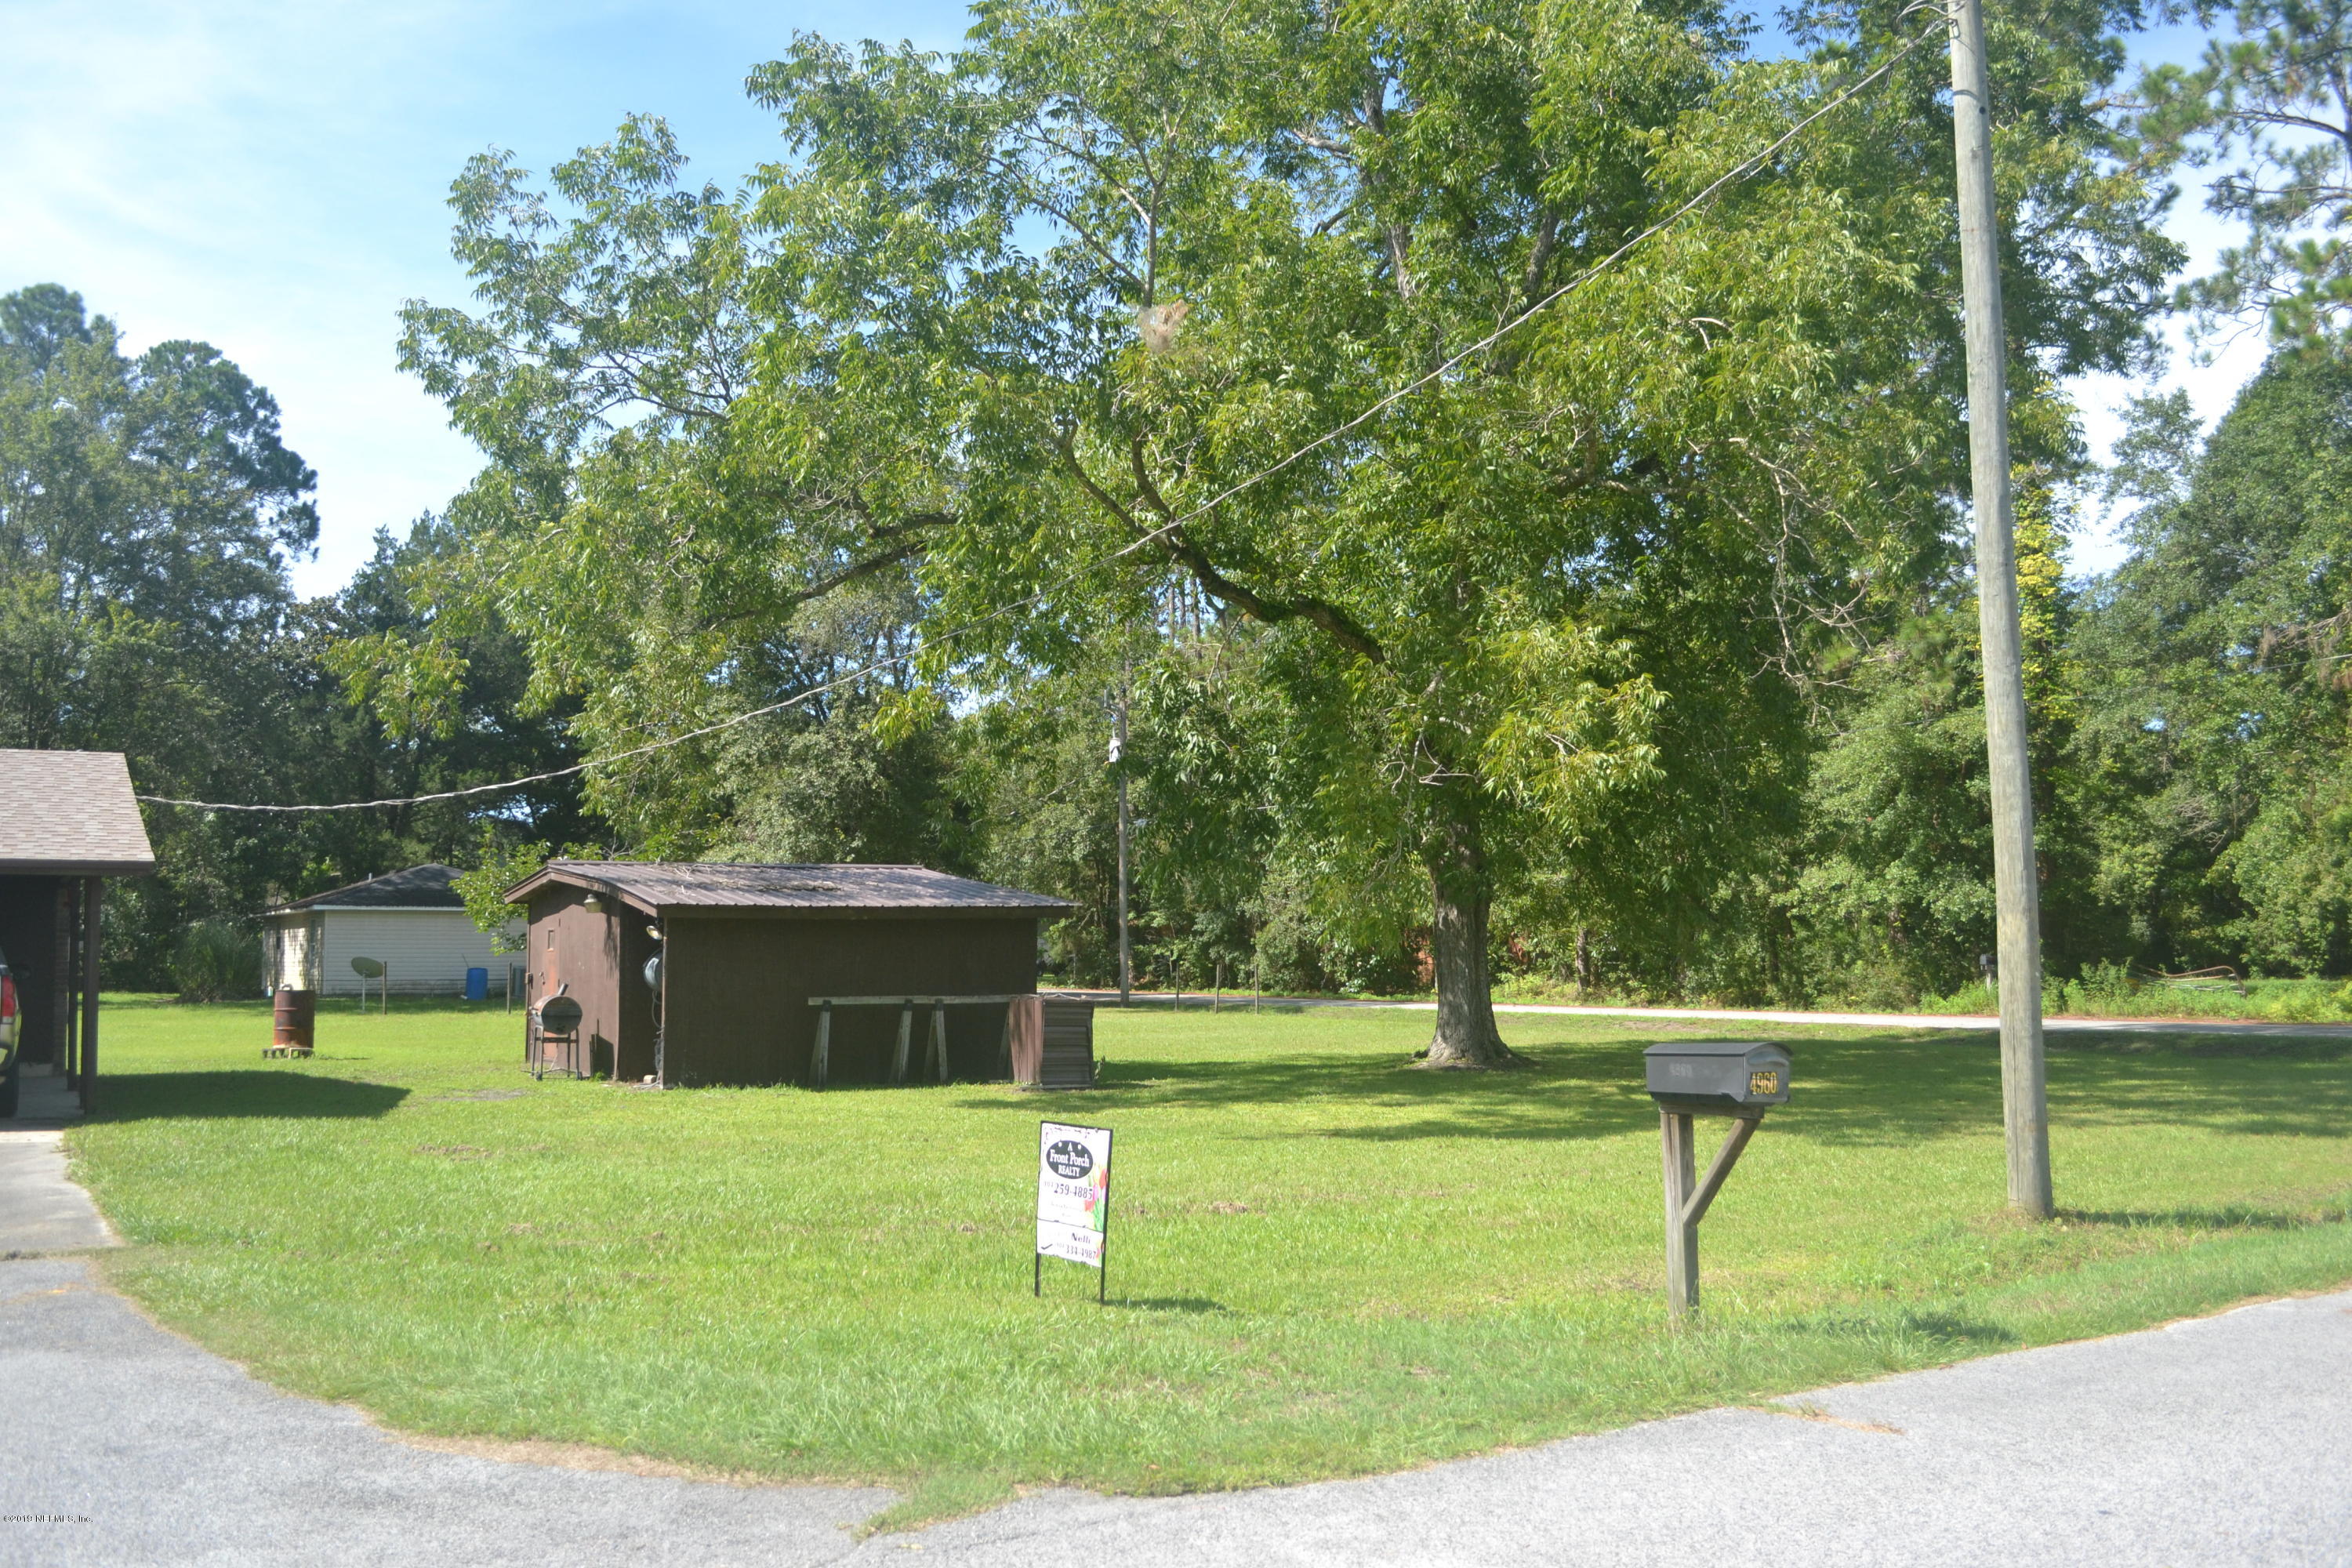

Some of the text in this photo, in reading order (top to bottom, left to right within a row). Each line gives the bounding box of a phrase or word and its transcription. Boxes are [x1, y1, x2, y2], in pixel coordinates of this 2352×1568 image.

[1750, 1072, 1777, 1094] 4960
[1067, 1142, 1073, 1152] A
[1050, 1149, 1090, 1167] Front Porch
[1058, 1164, 1080, 1177] REALTY
[1054, 1182, 1093, 1200] 259-4885
